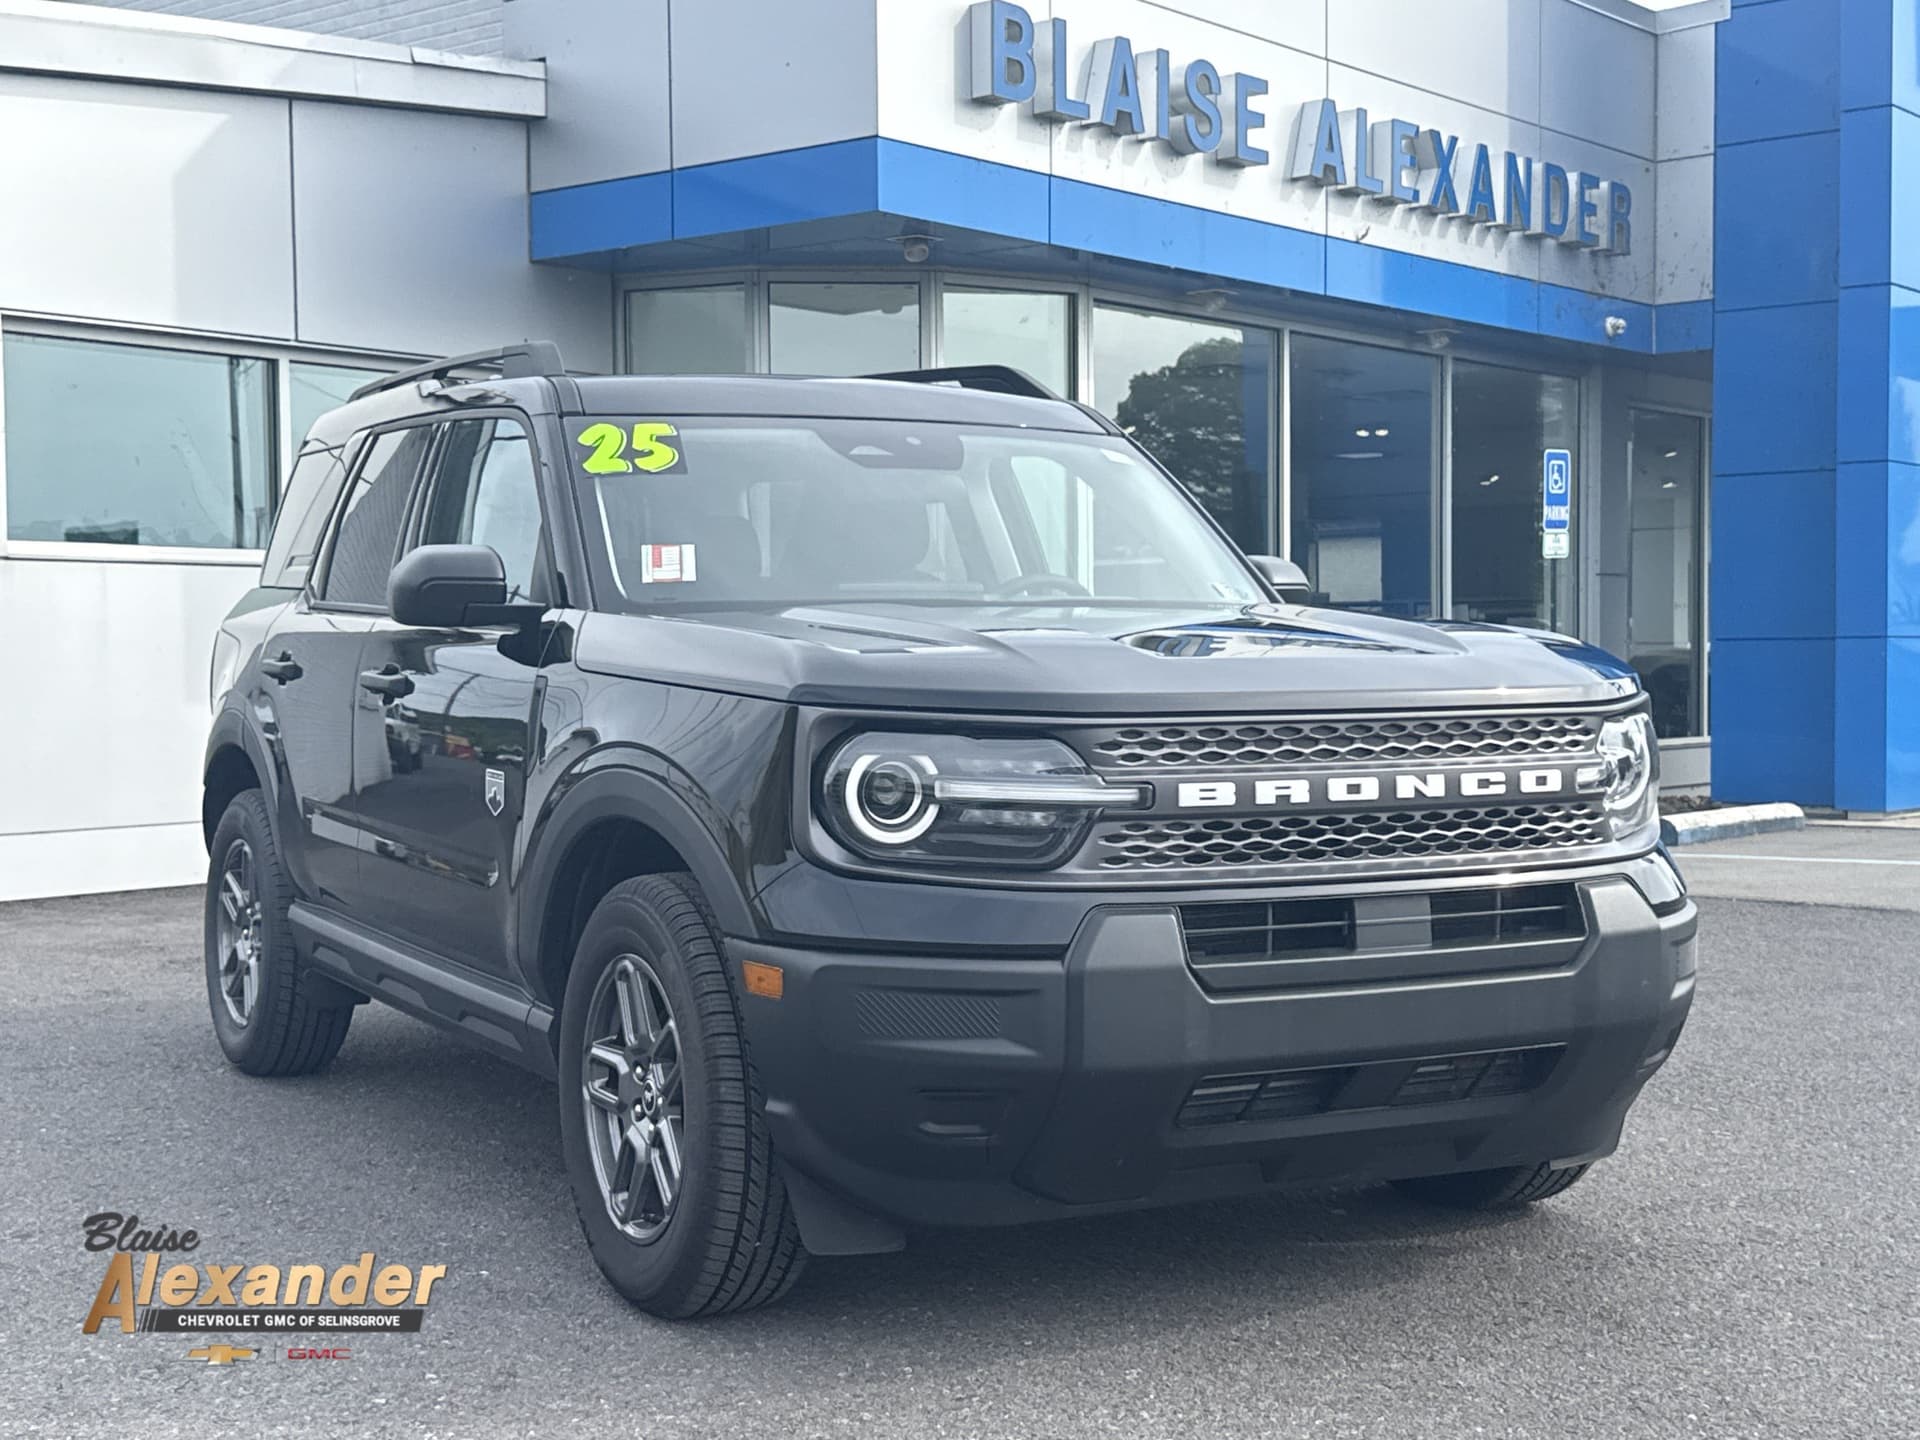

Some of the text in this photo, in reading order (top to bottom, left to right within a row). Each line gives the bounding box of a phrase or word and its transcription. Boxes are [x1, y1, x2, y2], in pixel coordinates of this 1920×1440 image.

[972, 1, 1632, 256] BLAISE ALEXANDER
[577, 422, 680, 475] 25
[1544, 505, 1569, 520] PARKING
[1177, 768, 1563, 807] BRONCO
